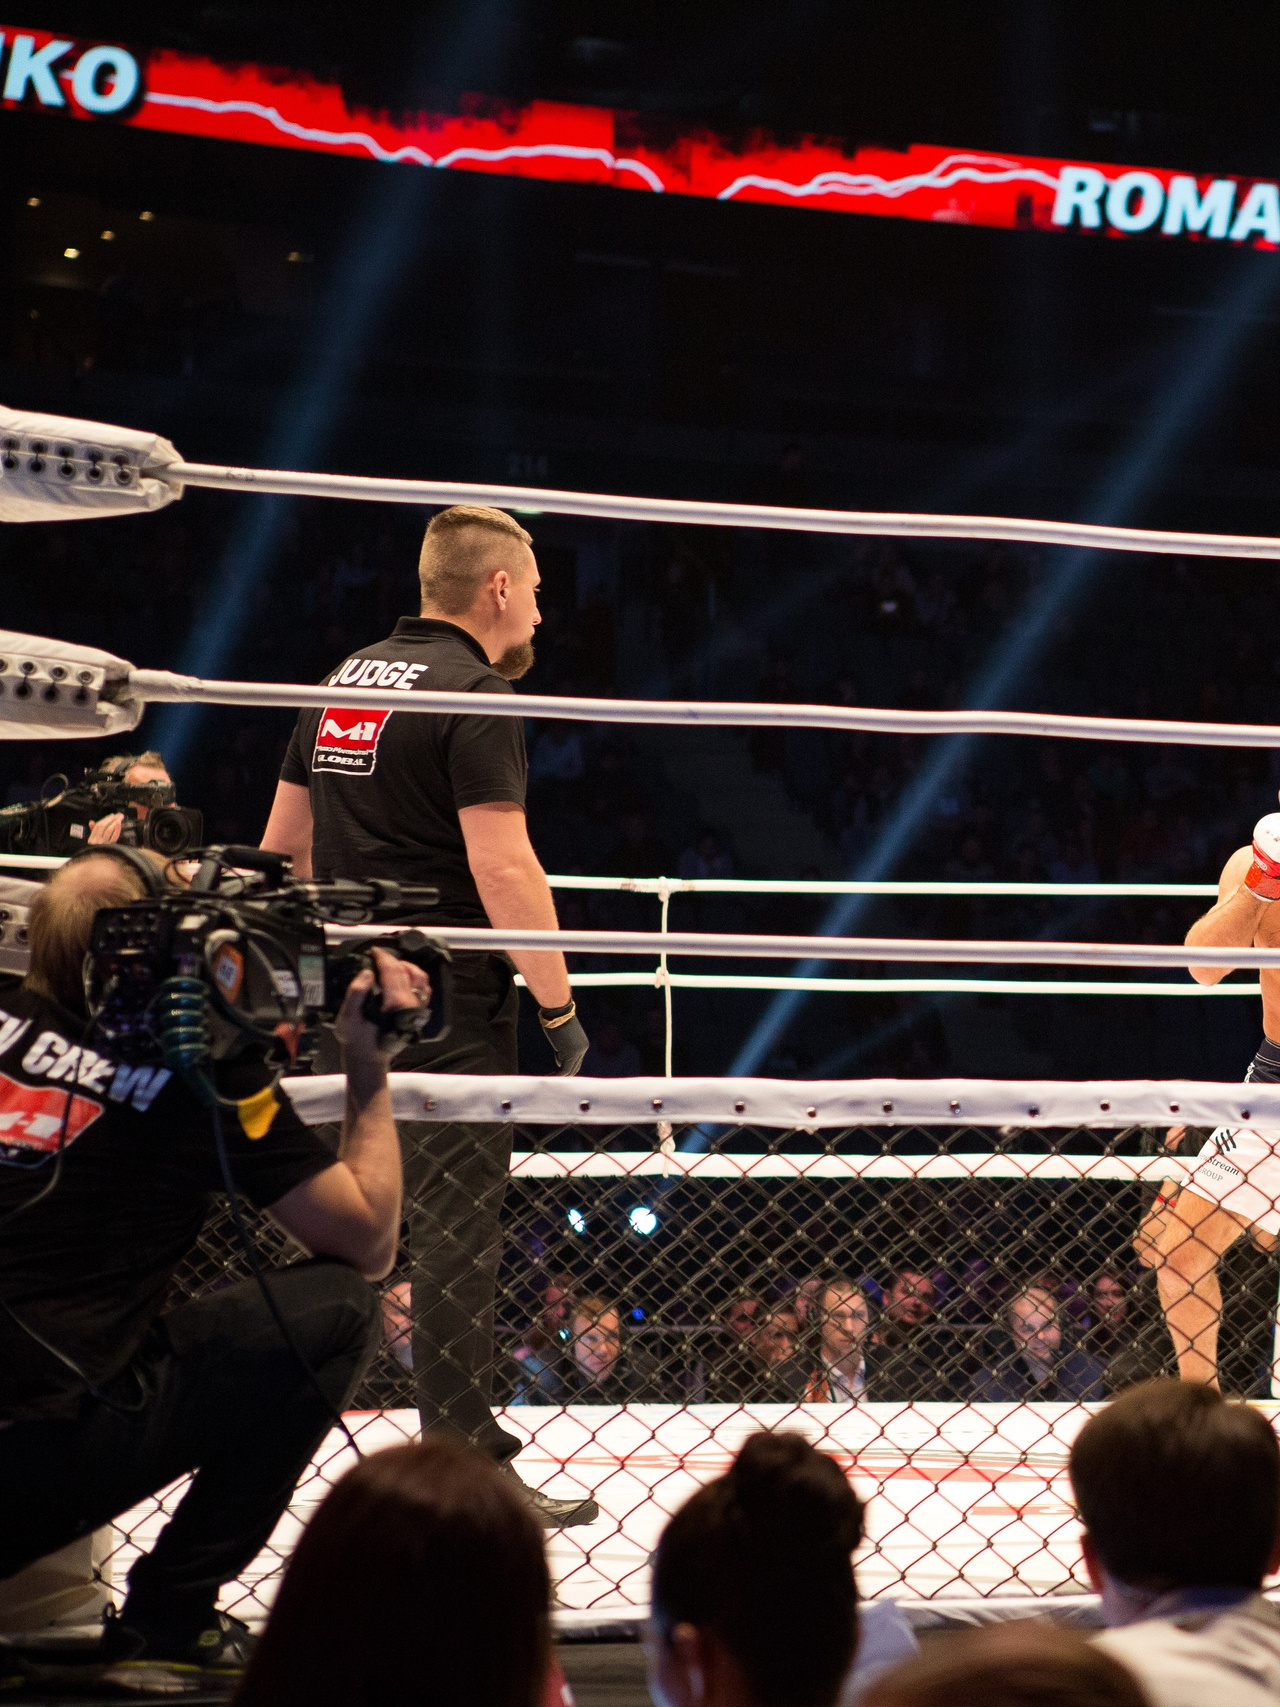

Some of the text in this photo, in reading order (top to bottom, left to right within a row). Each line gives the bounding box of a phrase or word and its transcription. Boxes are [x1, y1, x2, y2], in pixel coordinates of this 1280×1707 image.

[0, 31, 140, 114] KO
[327, 658, 429, 690] JUDGE
[321, 718, 377, 741] M-1
[0, 1009, 174, 1113] V CREW
[1200, 1154, 1240, 1176] ewStream
